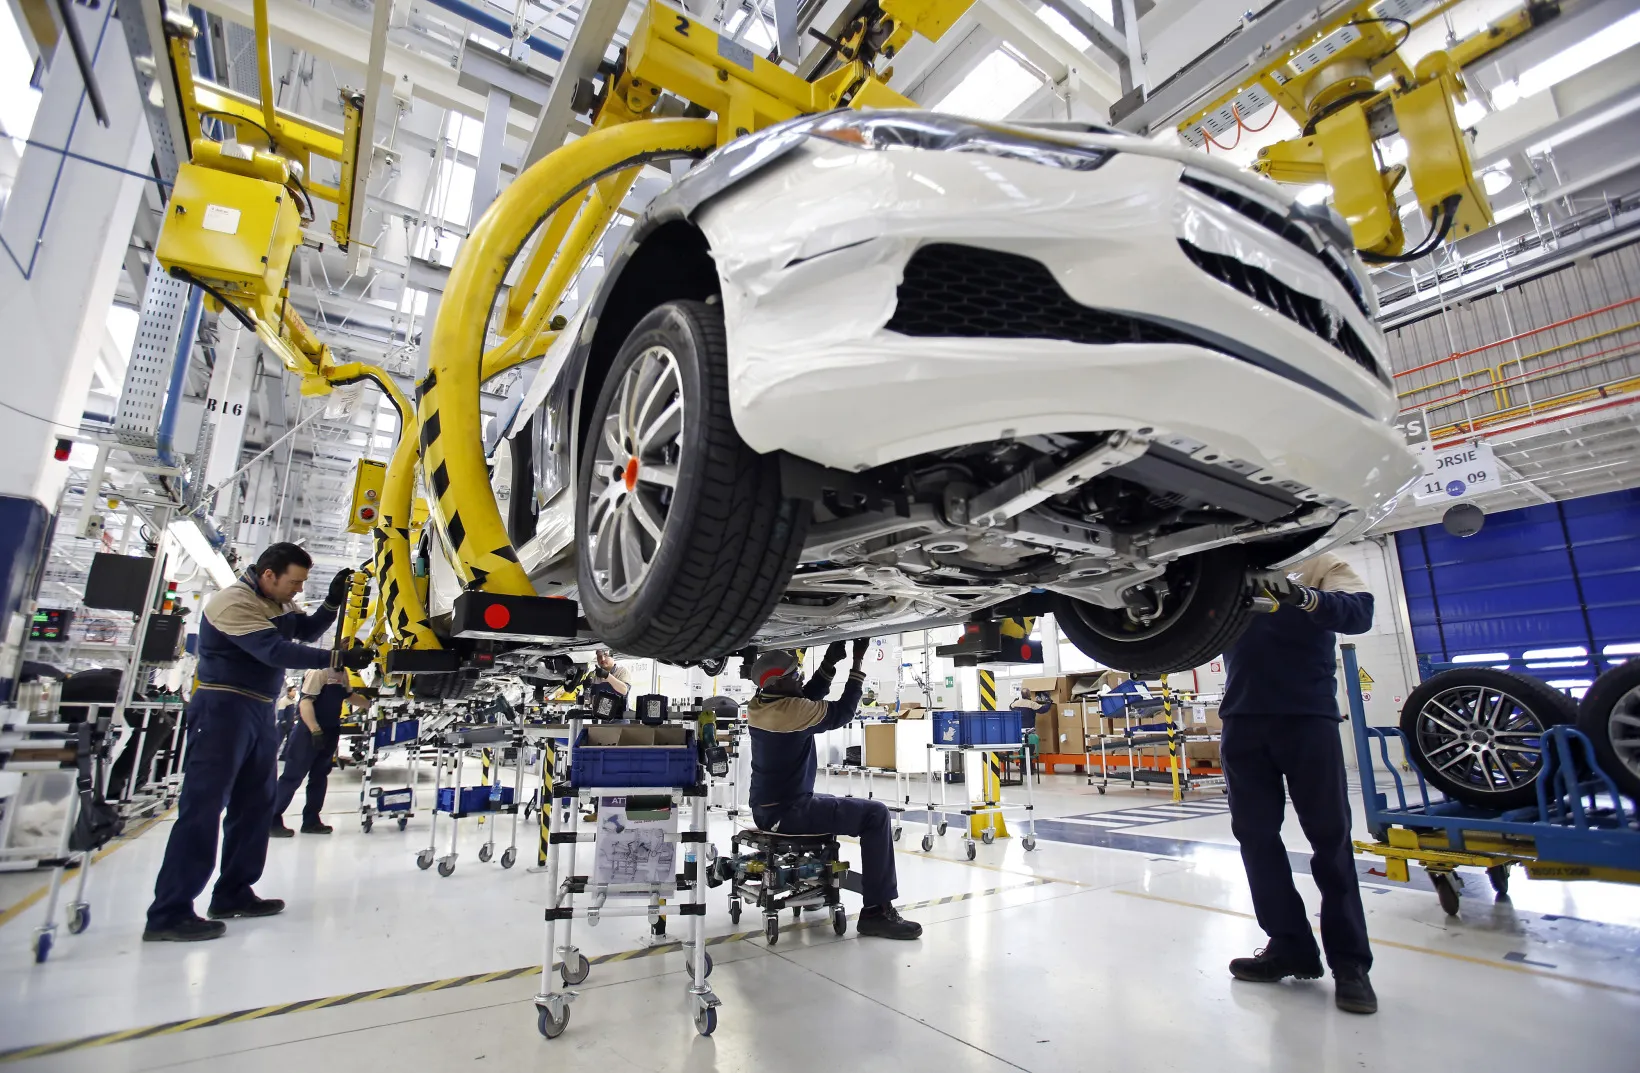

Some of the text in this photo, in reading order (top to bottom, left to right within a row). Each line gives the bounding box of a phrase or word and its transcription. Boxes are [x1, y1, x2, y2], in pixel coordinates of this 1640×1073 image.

[674, 15, 689, 37] 2
[207, 398, 242, 416] B16
[1425, 481, 1442, 493] 11
[1467, 471, 1486, 483] 09
